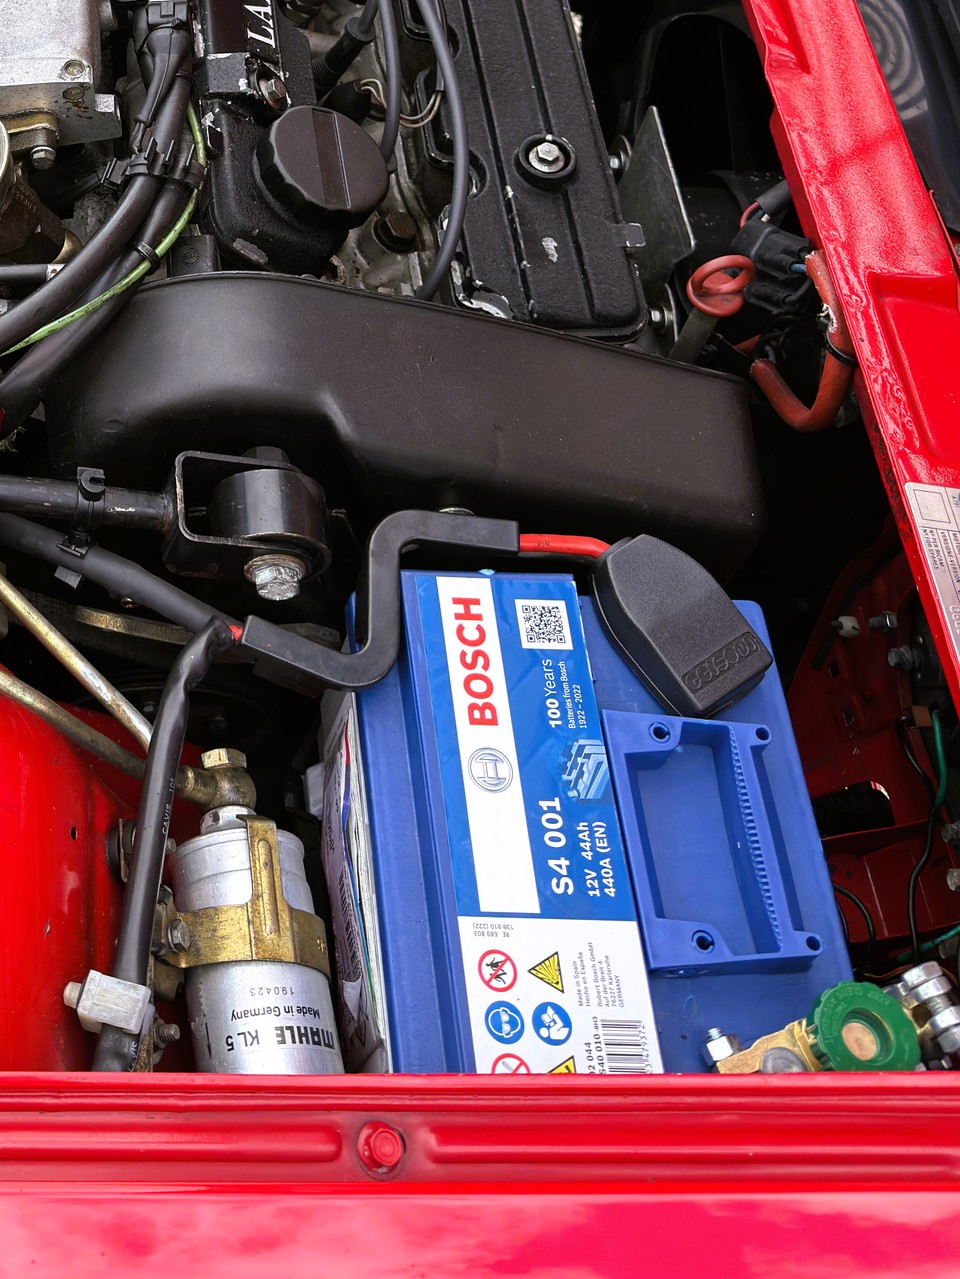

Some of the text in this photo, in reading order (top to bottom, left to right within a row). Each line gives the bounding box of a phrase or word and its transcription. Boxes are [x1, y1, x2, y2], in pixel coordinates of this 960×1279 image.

[929, 548, 939, 570] SPARES
[452, 597, 498, 726] BOSCH
[542, 659, 562, 728] 100 Years
[558, 661, 576, 729] Batteries from Bosch
[572, 684, 583, 703] 2022
[577, 710, 587, 729] 1922
[539, 797, 574, 895] S4 001
[577, 822, 600, 897] 12V 44Ah
[592, 821, 616, 897] 440A (EN)
[588, 942, 596, 962] GmbH
[573, 960, 581, 979] Spain
[604, 955, 614, 986] Karlsruhe
[576, 980, 581, 989] in
[583, 976, 588, 986] en
[615, 975, 624, 1008] GERMANY
[583, 987, 591, 1007] Hecho
[230, 1005, 320, 1021] Made in Germany
[226, 1025, 335, 1051] MAHLE KL 5
[593, 1034, 603, 1052] 010
[584, 1042, 594, 1062] 044
